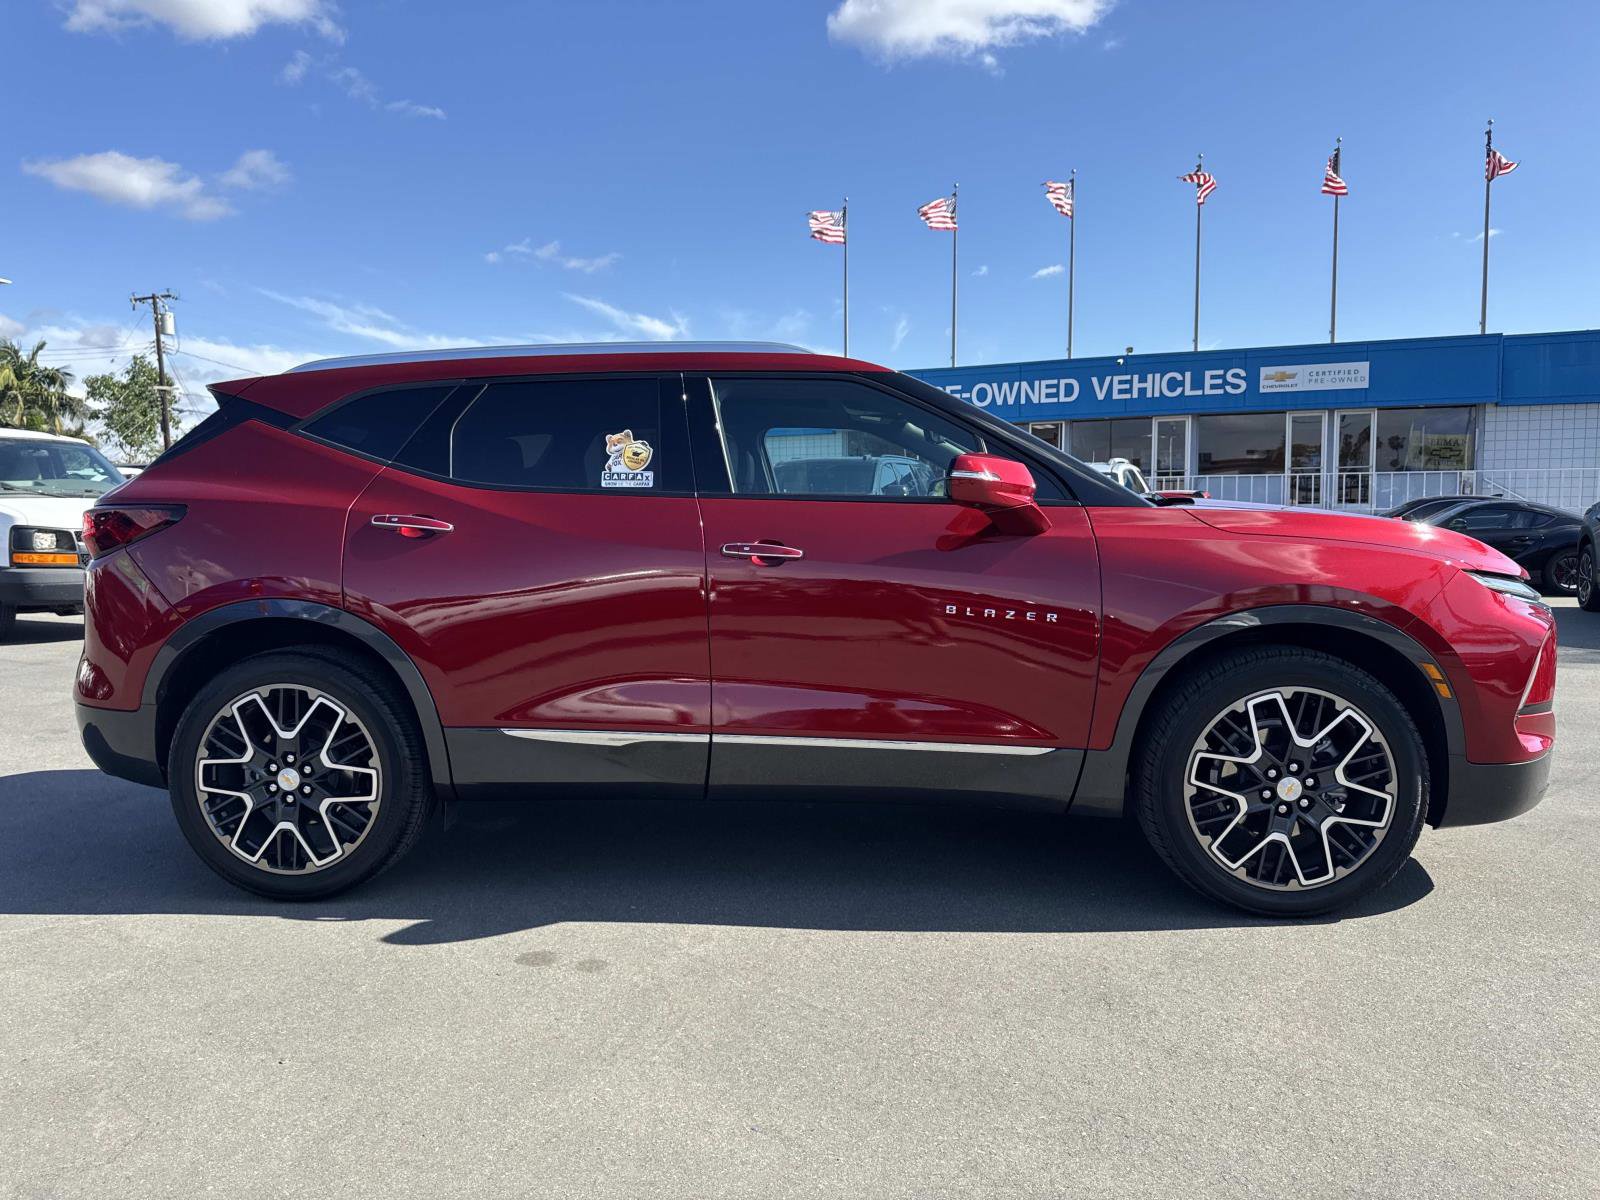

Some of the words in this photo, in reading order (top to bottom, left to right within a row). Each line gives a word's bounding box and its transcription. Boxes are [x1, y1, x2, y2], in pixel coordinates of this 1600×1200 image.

[1308, 369, 1360, 377] CERTIFIED
[1308, 376, 1366, 385] PRE-OWNED
[936, 378, 1080, 408] E-OWNED
[1091, 368, 1247, 400] VEHICLES
[604, 473, 650, 481] CARFAX
[945, 605, 1058, 623] BLAZER
